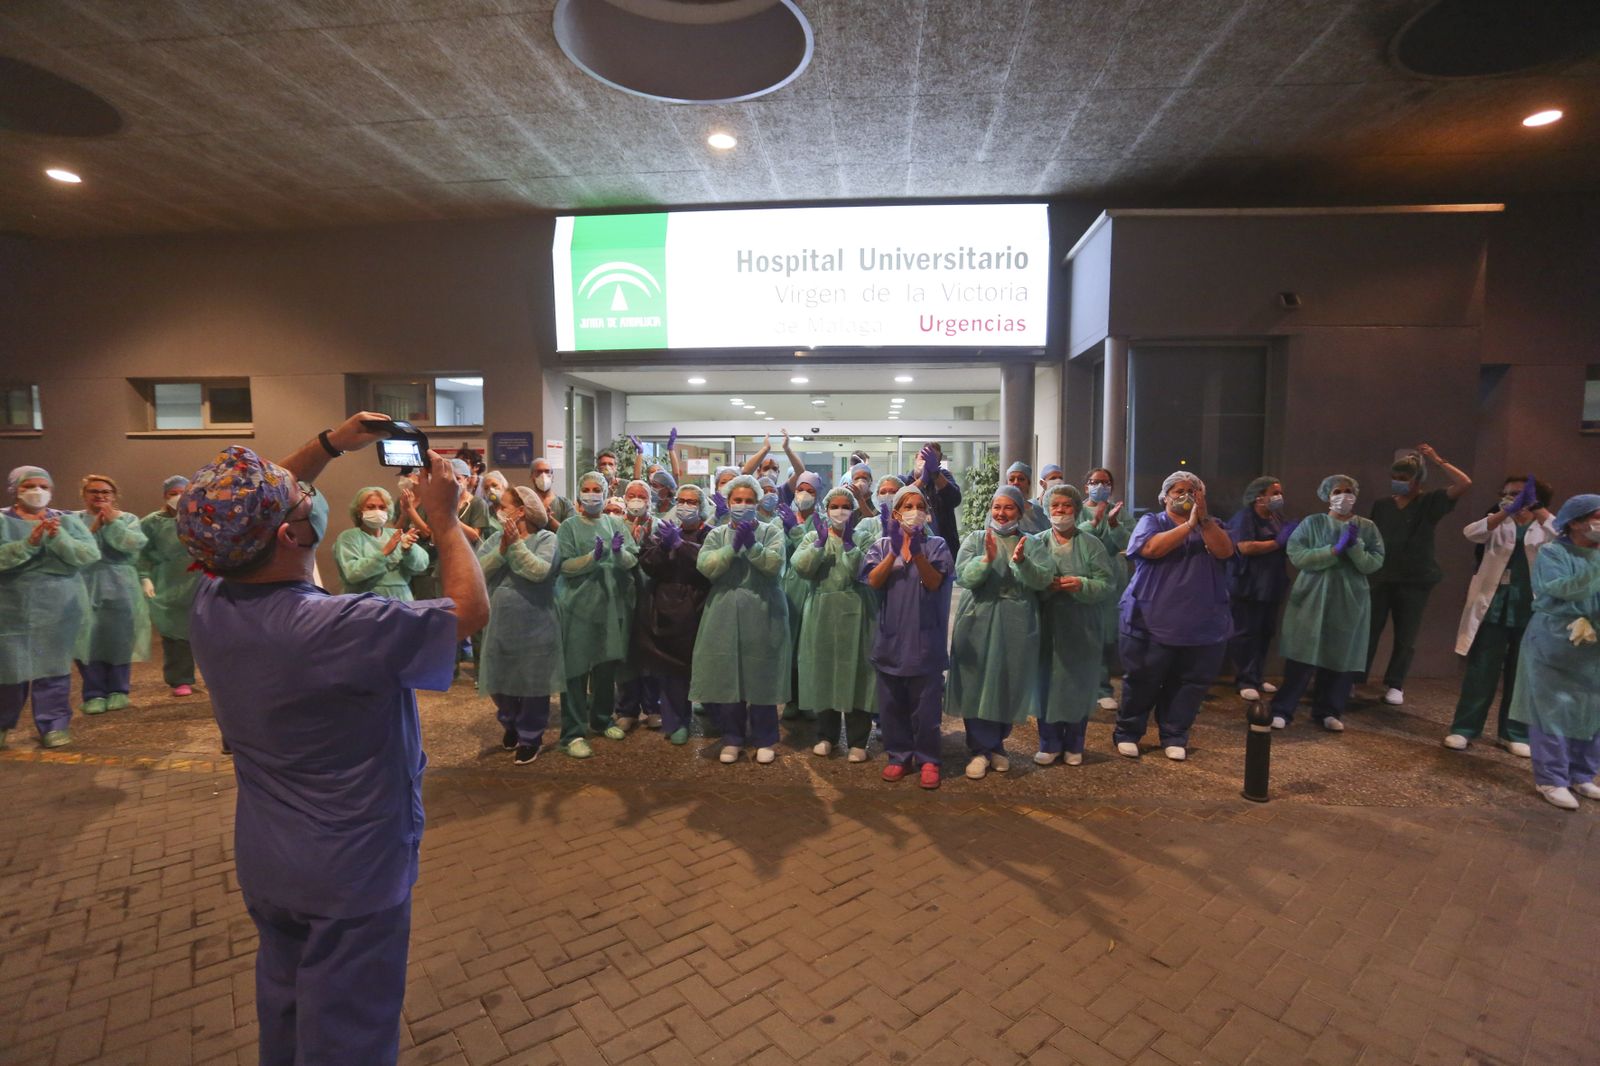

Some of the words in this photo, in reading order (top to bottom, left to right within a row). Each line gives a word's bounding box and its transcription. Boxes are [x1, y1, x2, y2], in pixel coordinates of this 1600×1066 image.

[737, 247, 844, 277] Hospital
[859, 245, 1029, 271] Universitario
[774, 284, 847, 308] Virgen
[861, 283, 891, 303] de
[906, 283, 926, 303] la
[940, 281, 1029, 302] Victoria
[919, 313, 1027, 337] Urgencias
